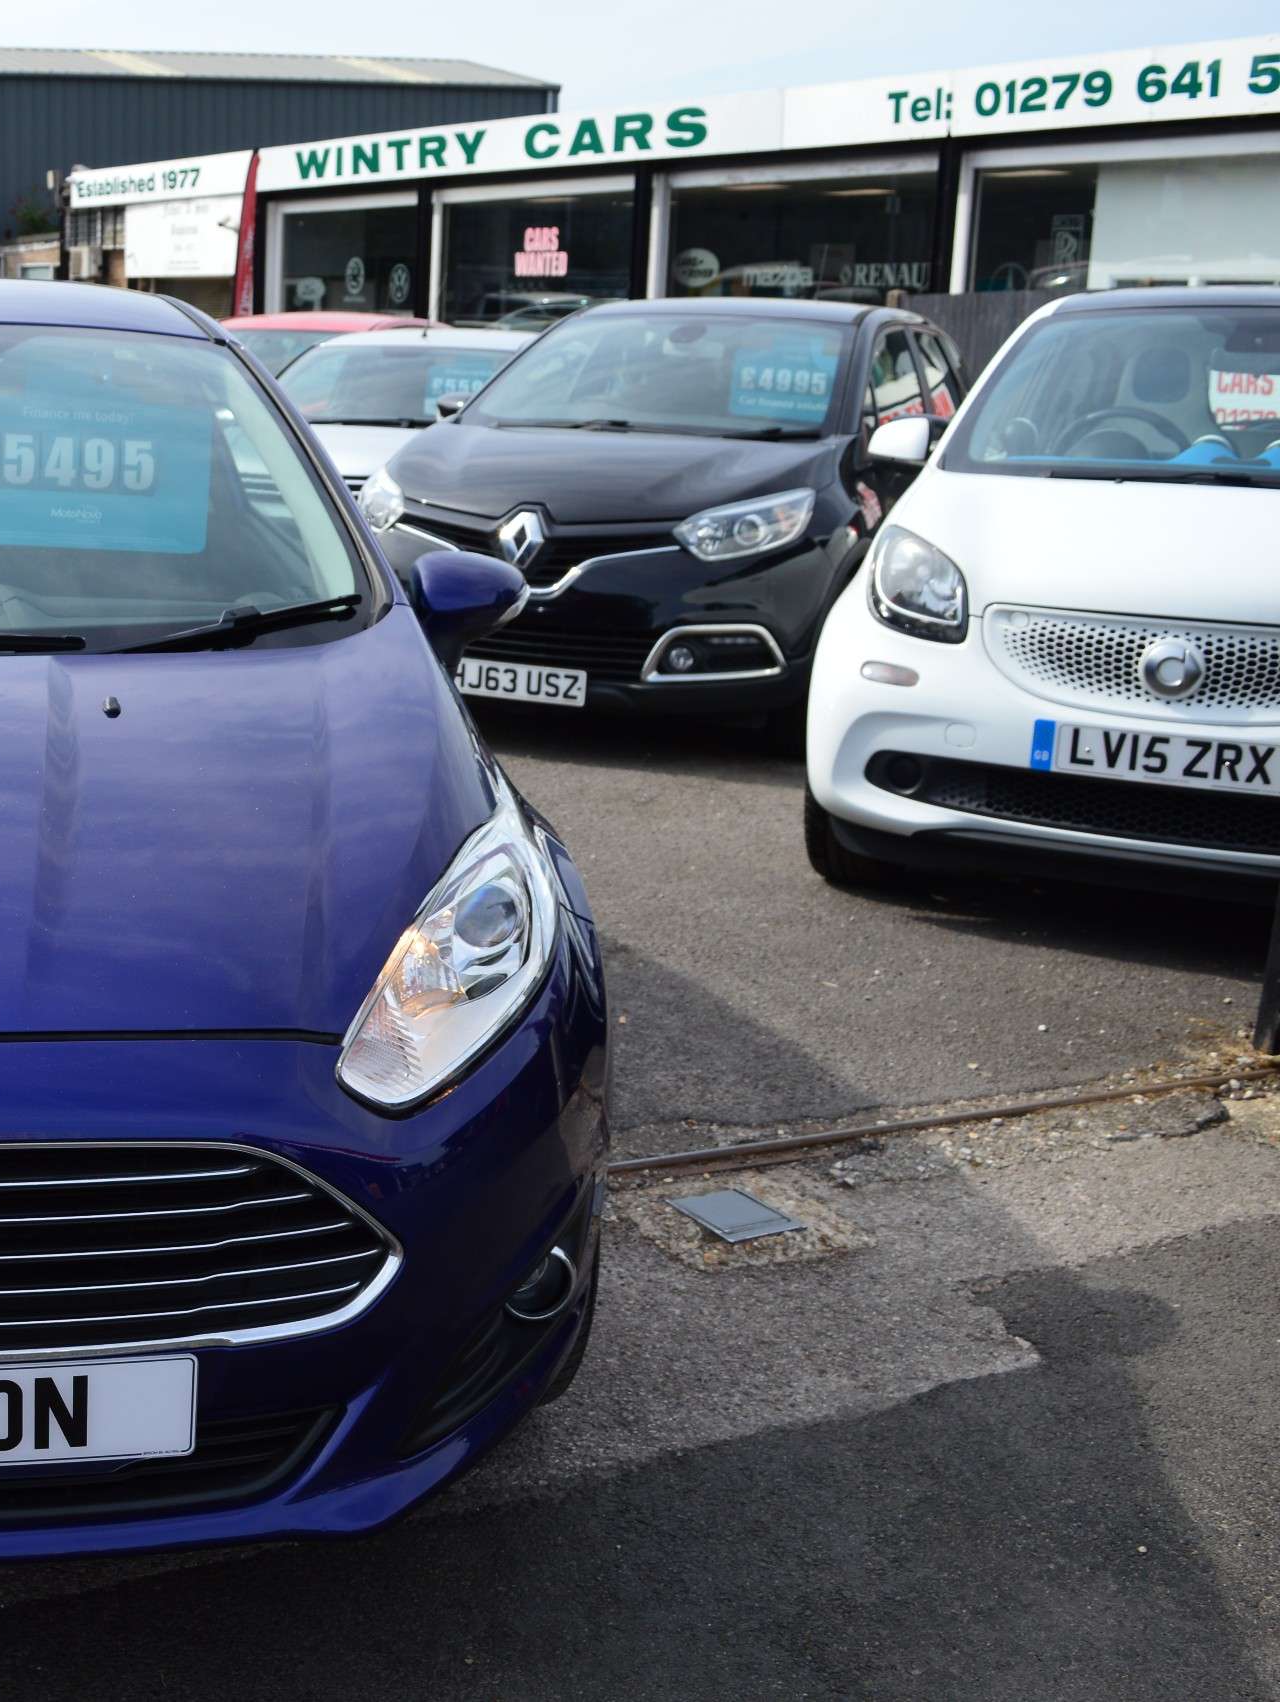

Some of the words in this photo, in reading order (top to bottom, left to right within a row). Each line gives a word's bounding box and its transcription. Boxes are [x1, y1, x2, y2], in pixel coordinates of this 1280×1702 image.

[888, 86, 952, 124] Tel:
[975, 69, 1113, 118] 01279
[1136, 59, 1222, 103] 641
[1248, 54, 1280, 96] 5
[295, 129, 487, 181] WINTRY
[523, 106, 709, 160] CARS
[76, 173, 156, 198] Established
[162, 168, 201, 191] 1977
[524, 226, 560, 251] CARS
[515, 251, 568, 277] WANTED
[1216, 370, 1274, 395] CARS
[526, 670, 580, 700] USZ
[1070, 727, 1170, 774] LV15
[1182, 739, 1275, 785] ZRX
